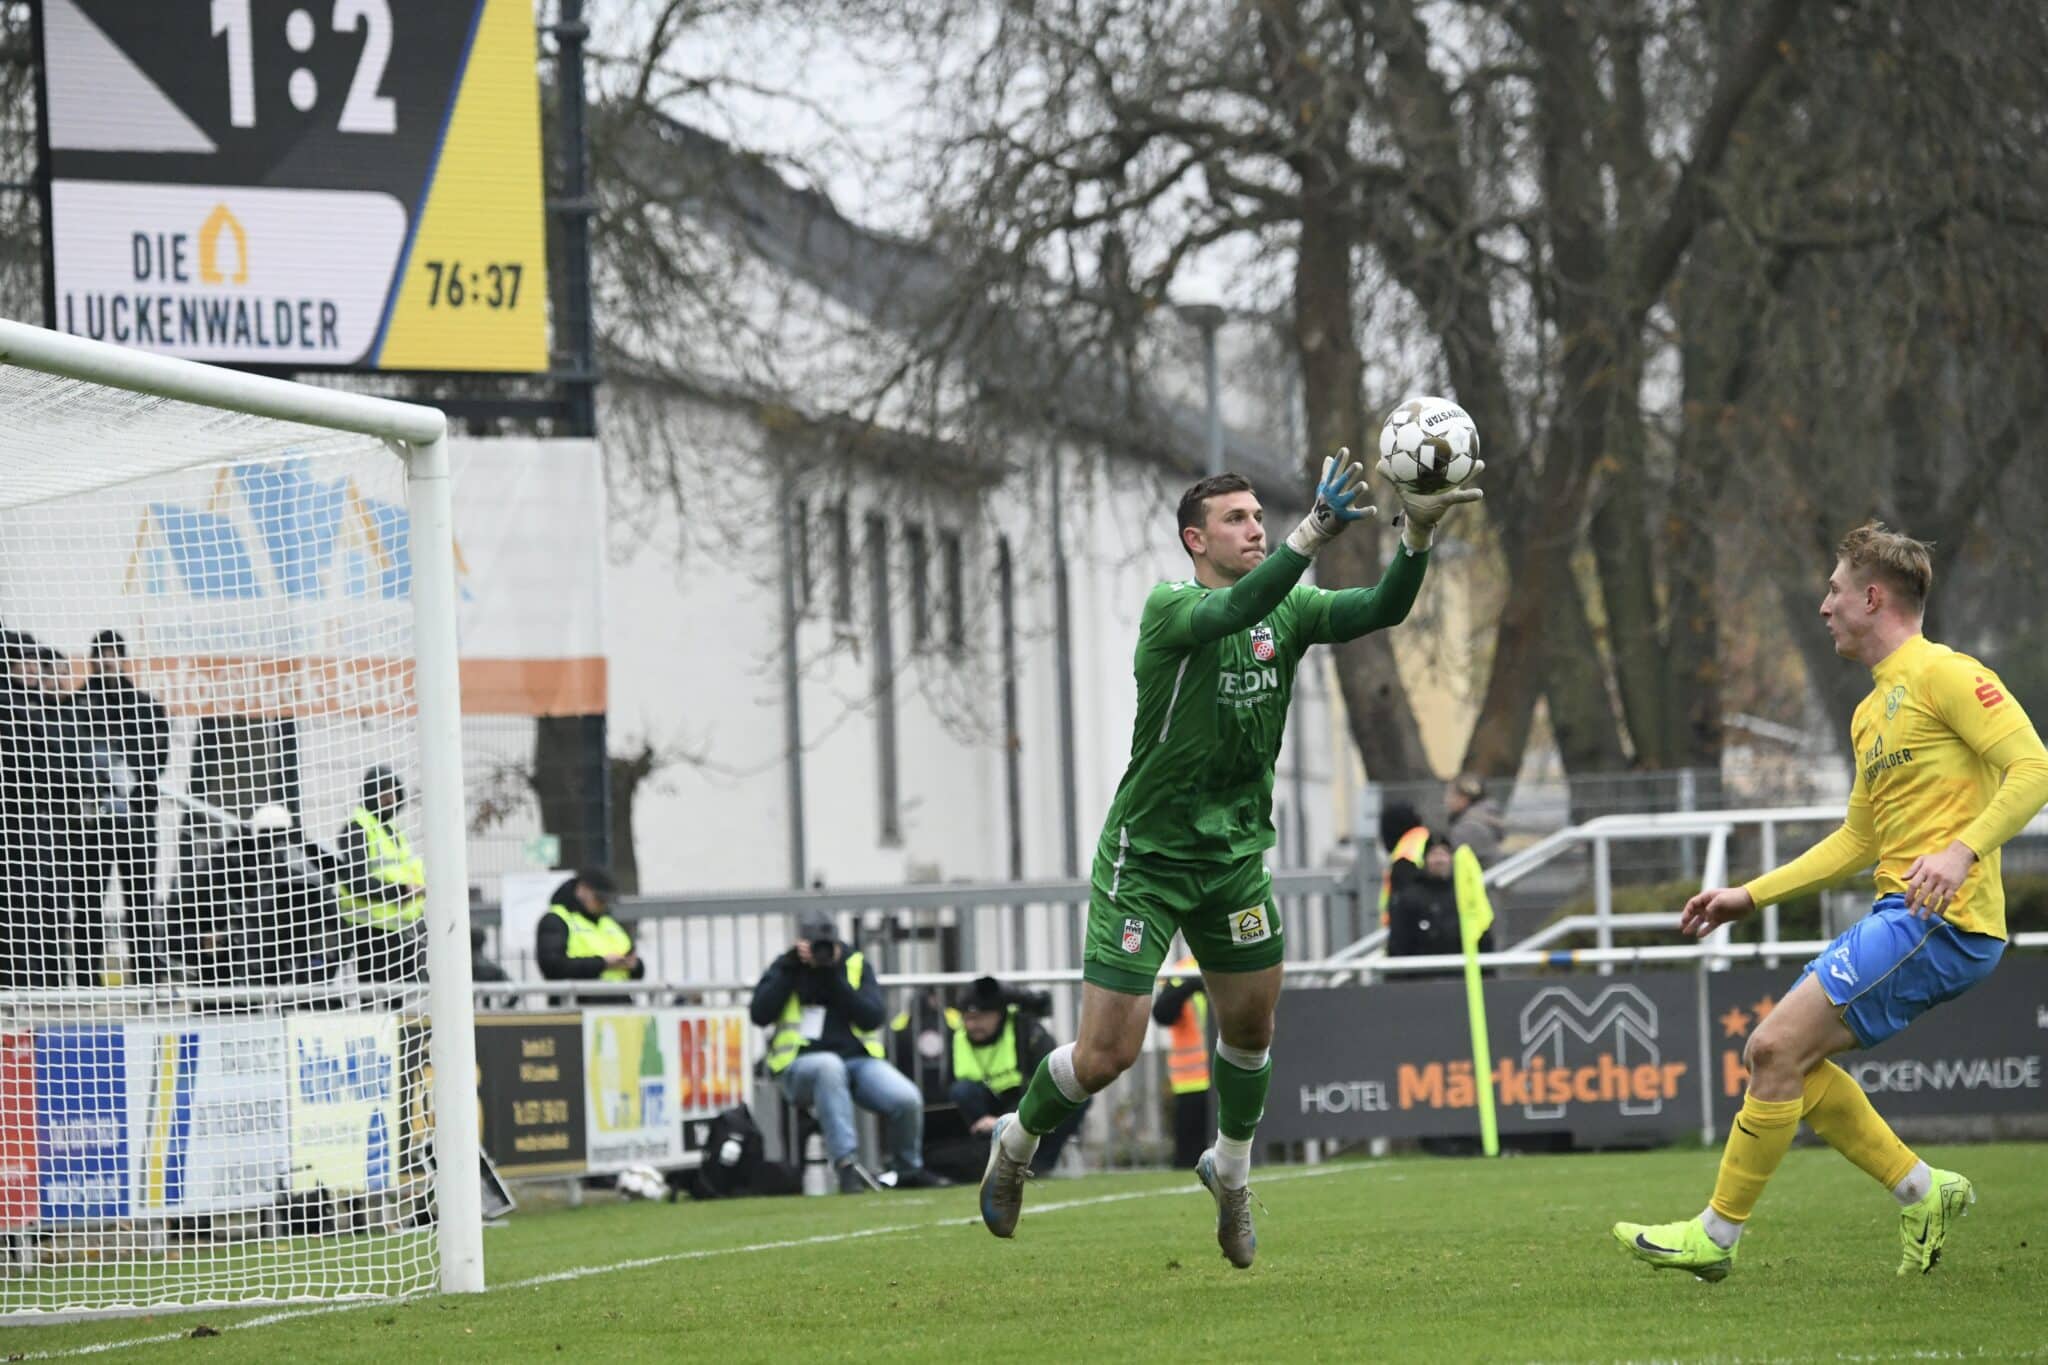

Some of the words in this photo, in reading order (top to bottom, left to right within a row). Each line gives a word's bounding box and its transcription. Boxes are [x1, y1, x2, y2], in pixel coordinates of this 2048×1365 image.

[210, 0, 397, 134] 1:2
[131, 231, 189, 283] DIE
[425, 260, 523, 310] 76:37
[66, 291, 340, 349] LUCKENWALDER
[1299, 1080, 1390, 1115] HOTEL
[1849, 1055, 2041, 1094] CKENWALDE
